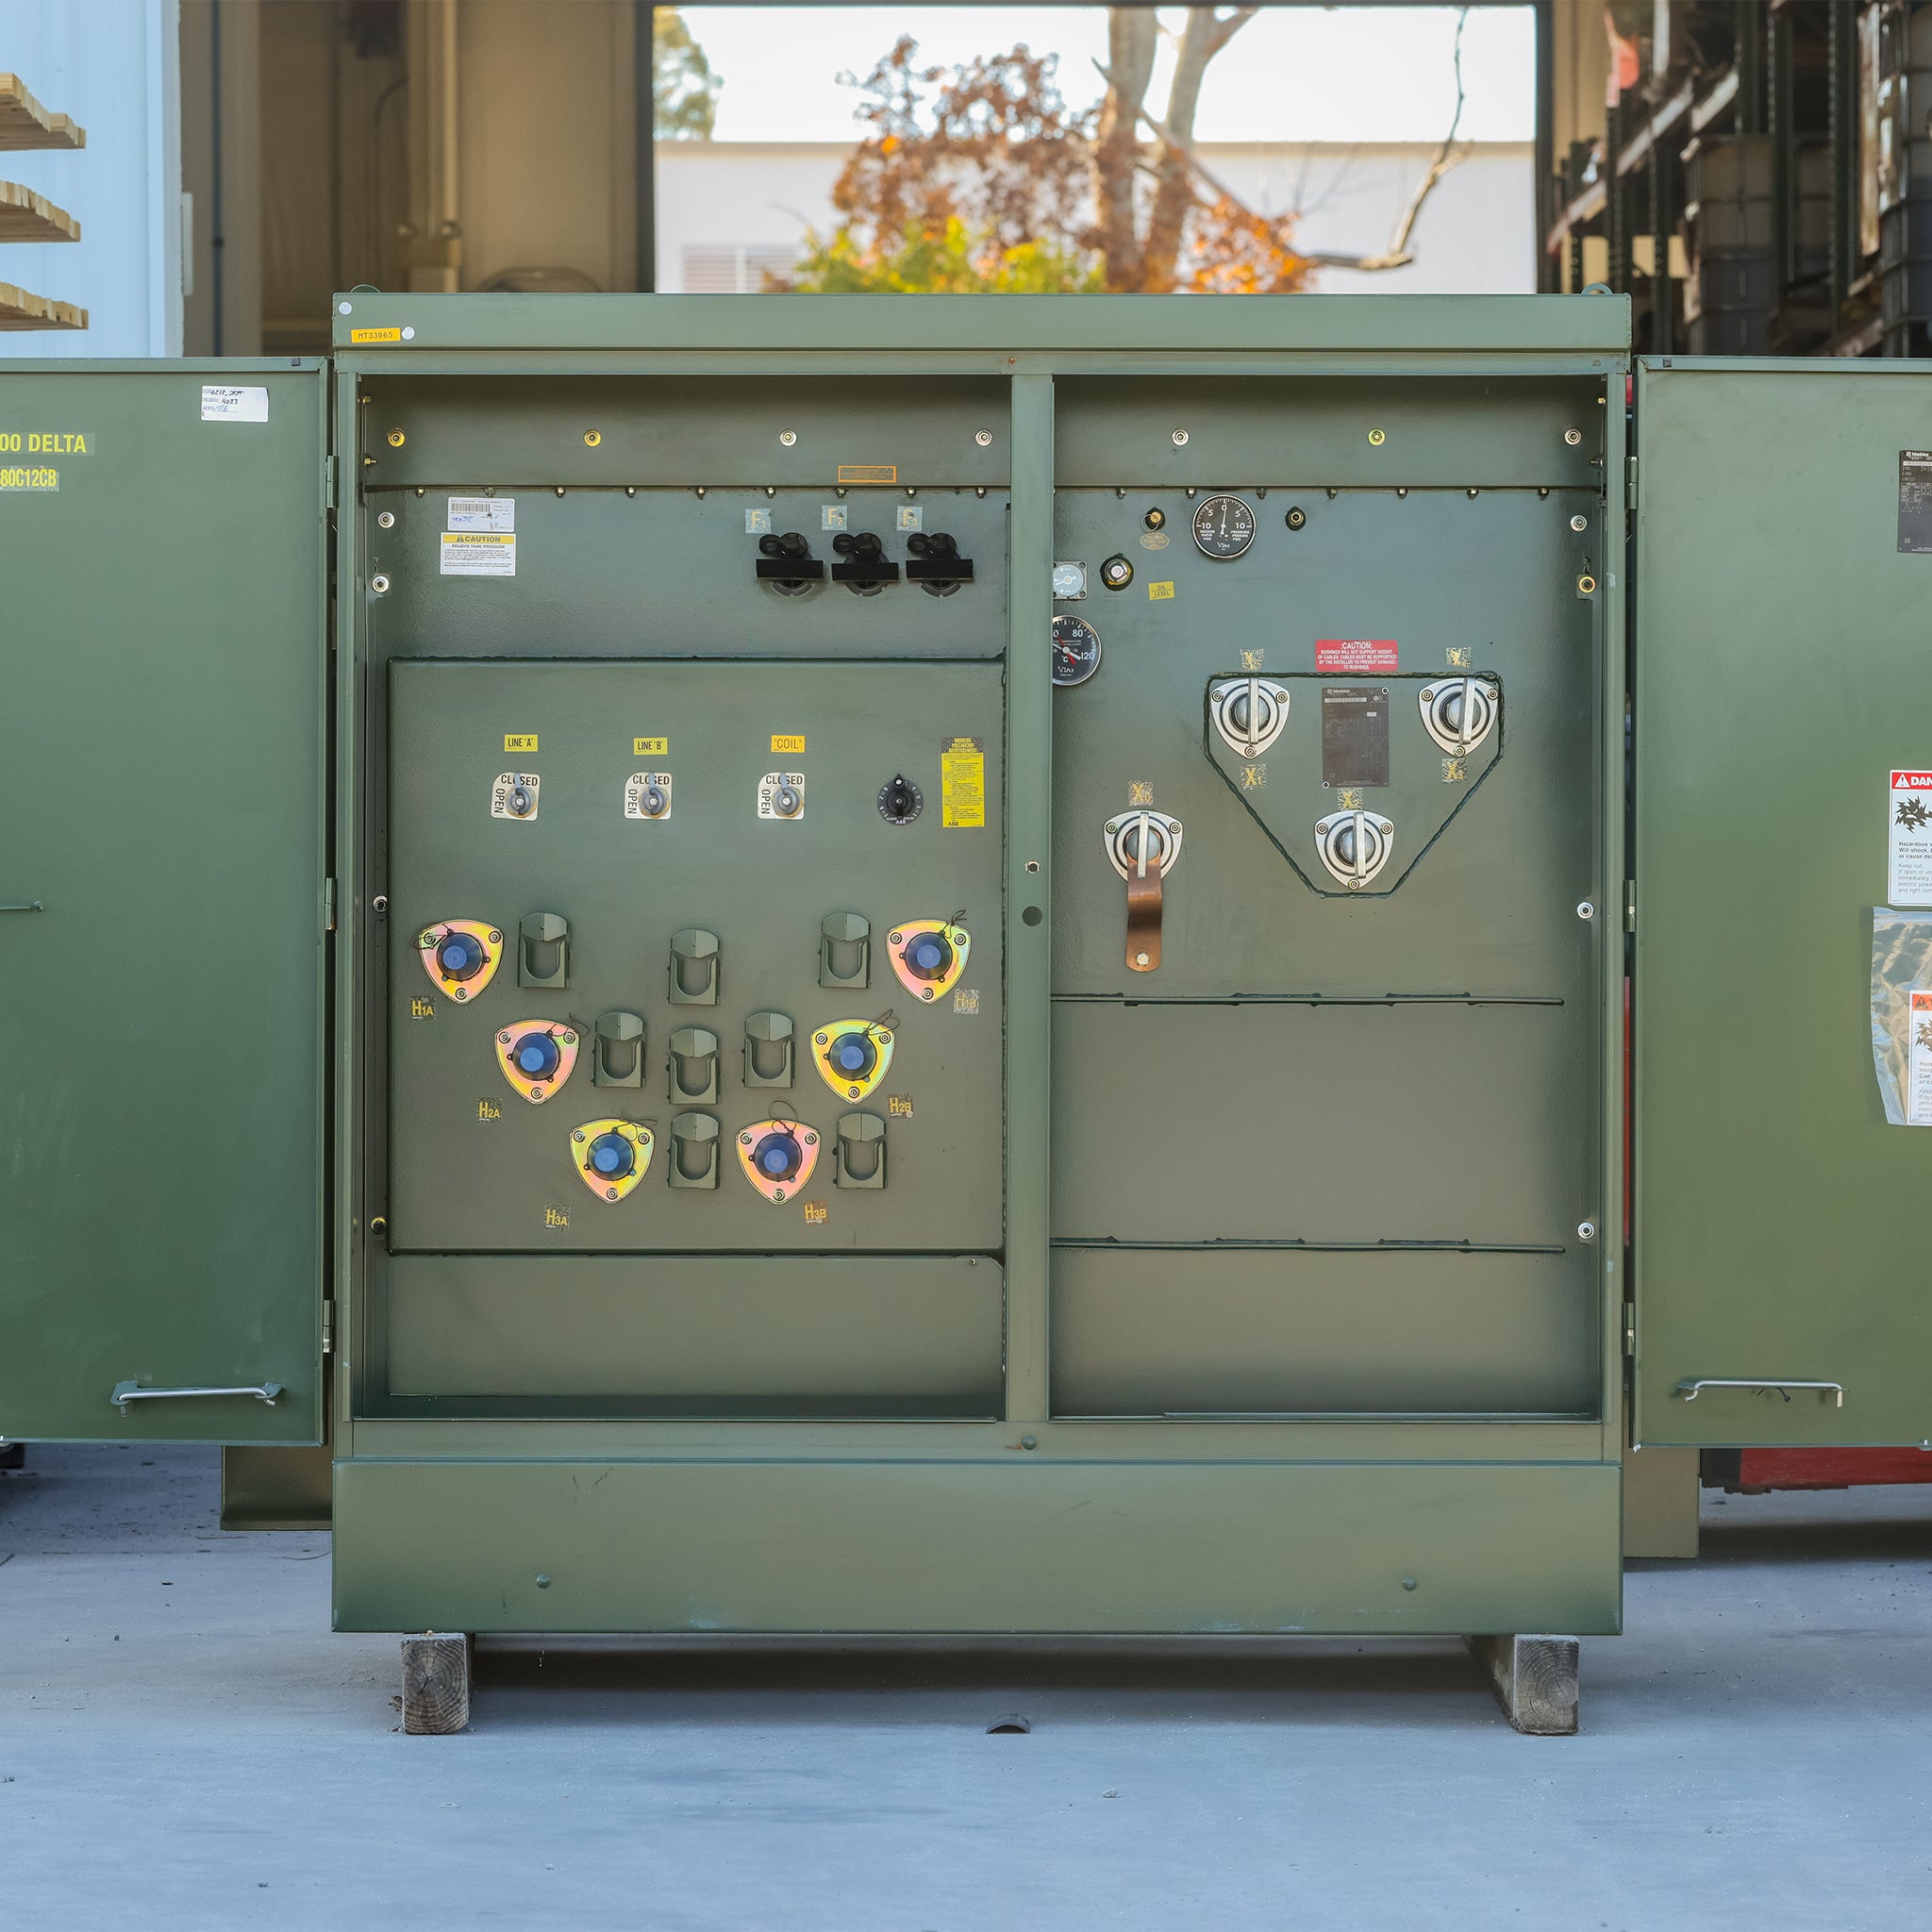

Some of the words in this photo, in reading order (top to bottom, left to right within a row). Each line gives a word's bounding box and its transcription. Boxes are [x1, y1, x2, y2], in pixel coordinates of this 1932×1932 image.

[28, 433, 87, 453] DELTA
[0, 468, 57, 488] 80C12CB
[1208, 508, 1214, 517] 5
[1235, 509, 1241, 518] 5
[1072, 629, 1084, 638] 80
[1080, 652, 1094, 660] 120
[508, 738, 523, 747] LINE
[638, 741, 653, 751] LINE
[501, 774, 539, 787] CLSED
[494, 788, 506, 814] OPEN
[627, 789, 639, 814] OPEN
[760, 789, 772, 814] OPEN
[411, 1000, 434, 1016] H1A
[478, 1101, 501, 1118] H2A
[546, 1208, 568, 1226] H3A
[804, 1204, 826, 1220] H3B
